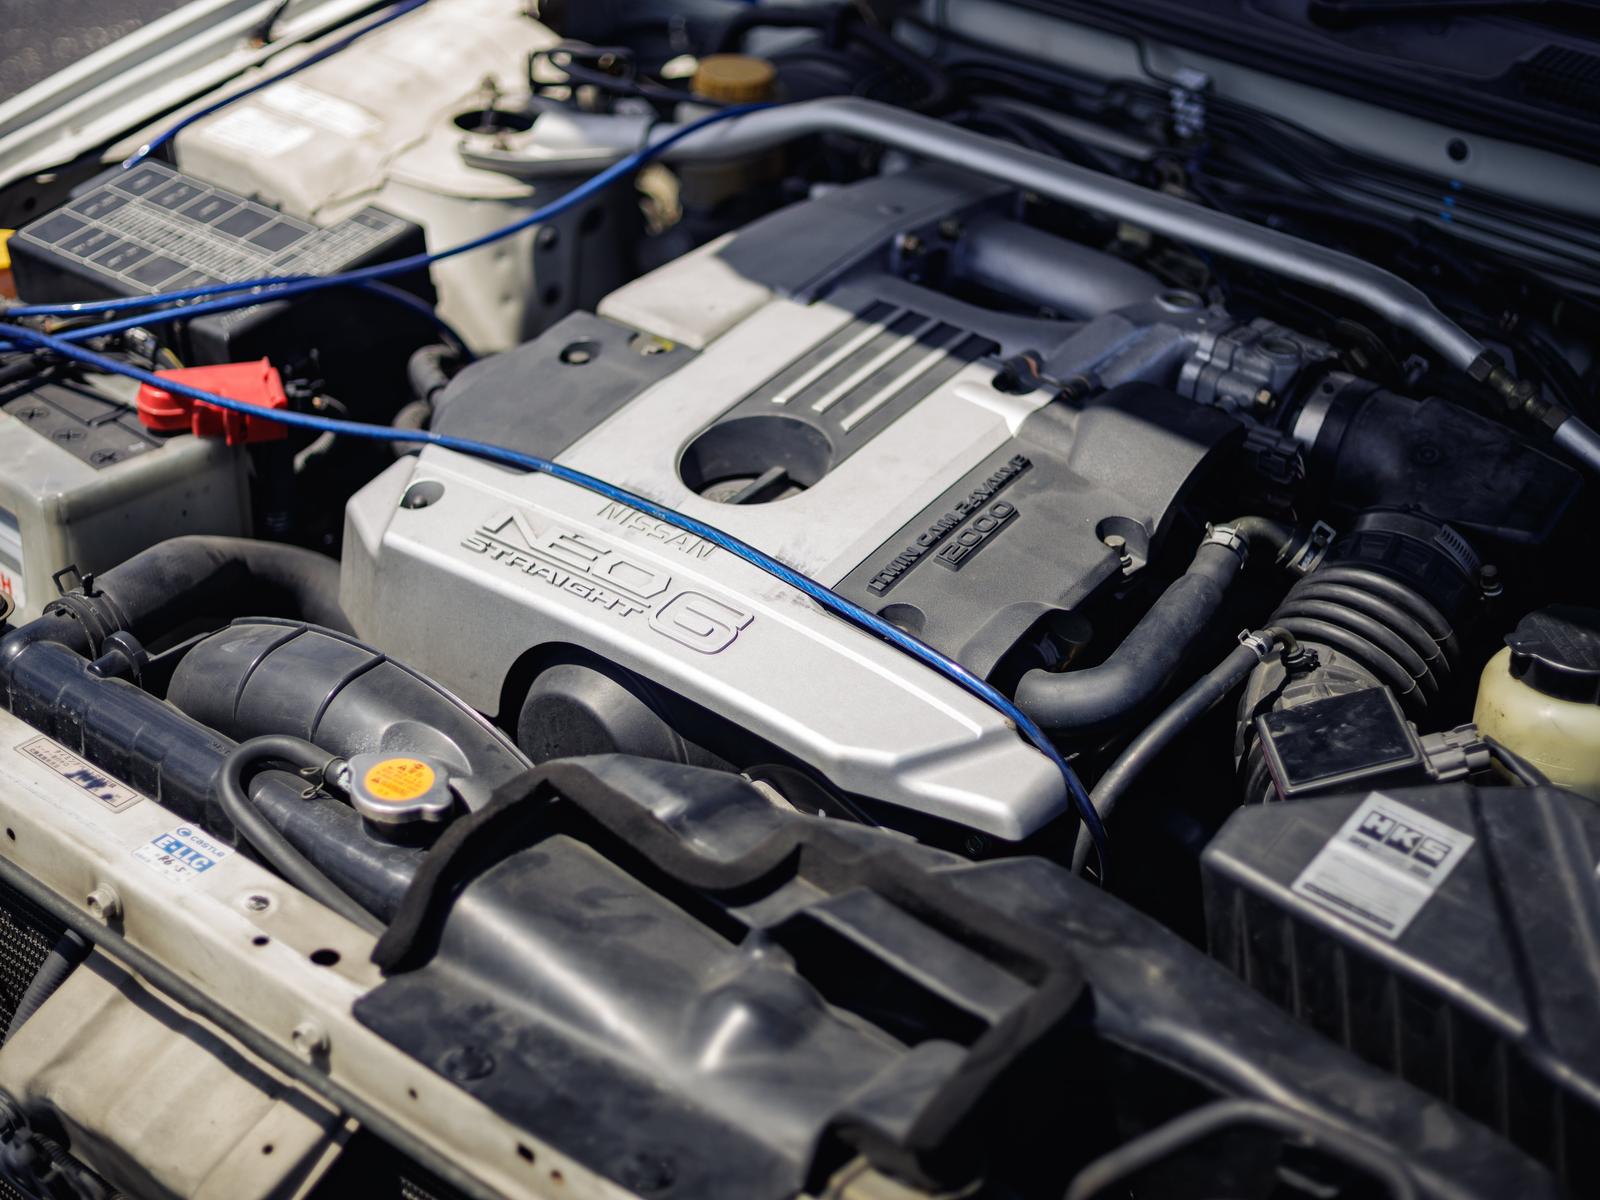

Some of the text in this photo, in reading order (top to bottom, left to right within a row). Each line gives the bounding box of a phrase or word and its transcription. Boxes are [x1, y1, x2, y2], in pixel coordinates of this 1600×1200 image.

[480, 507, 672, 599] NEO
[596, 501, 719, 560] NISSAN
[868, 547, 920, 592] TWIN
[916, 512, 961, 550] CAM
[938, 501, 1016, 562] 2000
[461, 533, 754, 655] STRAIGHT 6
[1359, 811, 1451, 864] HKS
